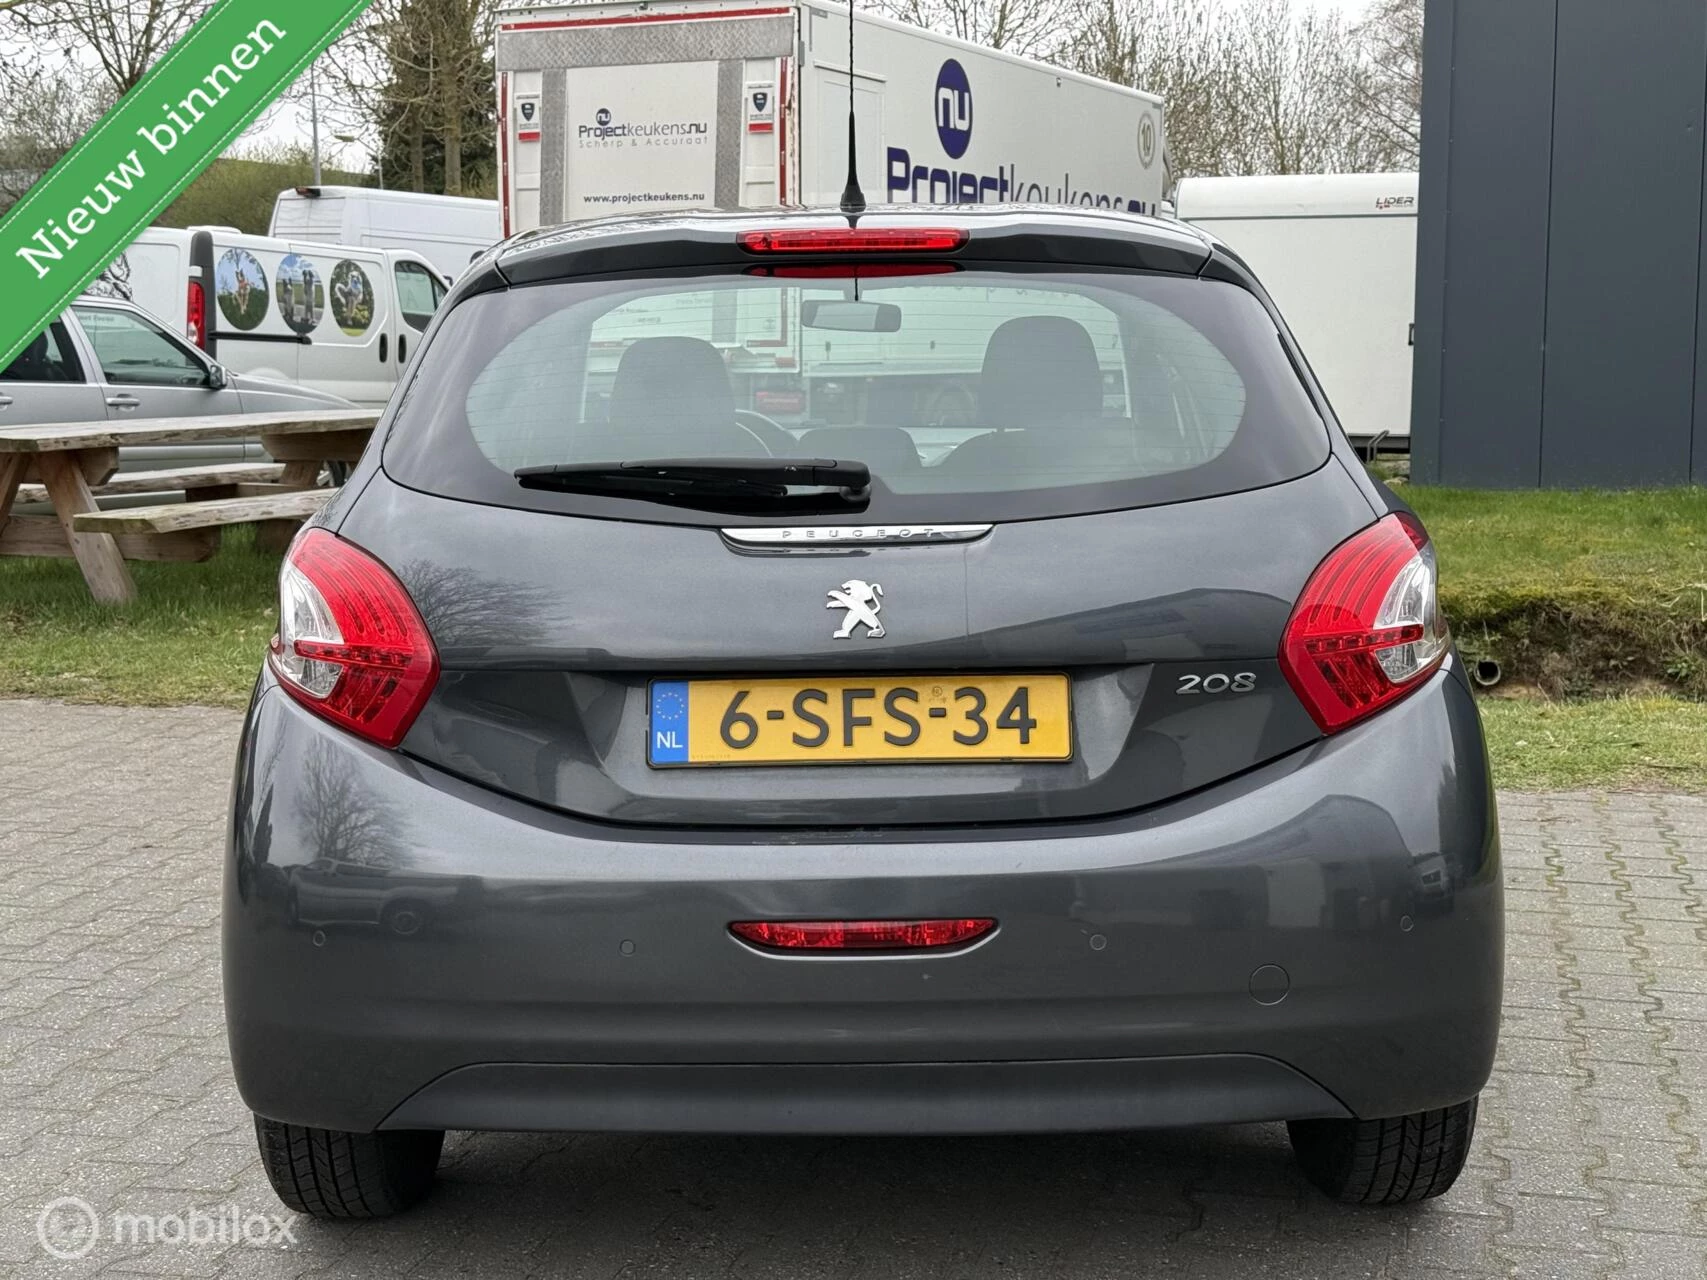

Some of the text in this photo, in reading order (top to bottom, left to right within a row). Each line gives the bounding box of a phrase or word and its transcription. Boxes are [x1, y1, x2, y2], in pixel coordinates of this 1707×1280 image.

[579, 122, 708, 140] Projectkeukens.nu
[1141, 123, 1152, 156] 10
[579, 136, 708, 149] Scherp & Accuraat
[887, 146, 1156, 216] Projectkk
[583, 192, 705, 205] www.projectkeukens.nu
[1376, 196, 1415, 205] LIDER
[782, 528, 934, 538] PEUGEOT
[1176, 672, 1257, 694] 208
[656, 730, 683, 749] NL
[719, 686, 1037, 749] 6-SFS-34
